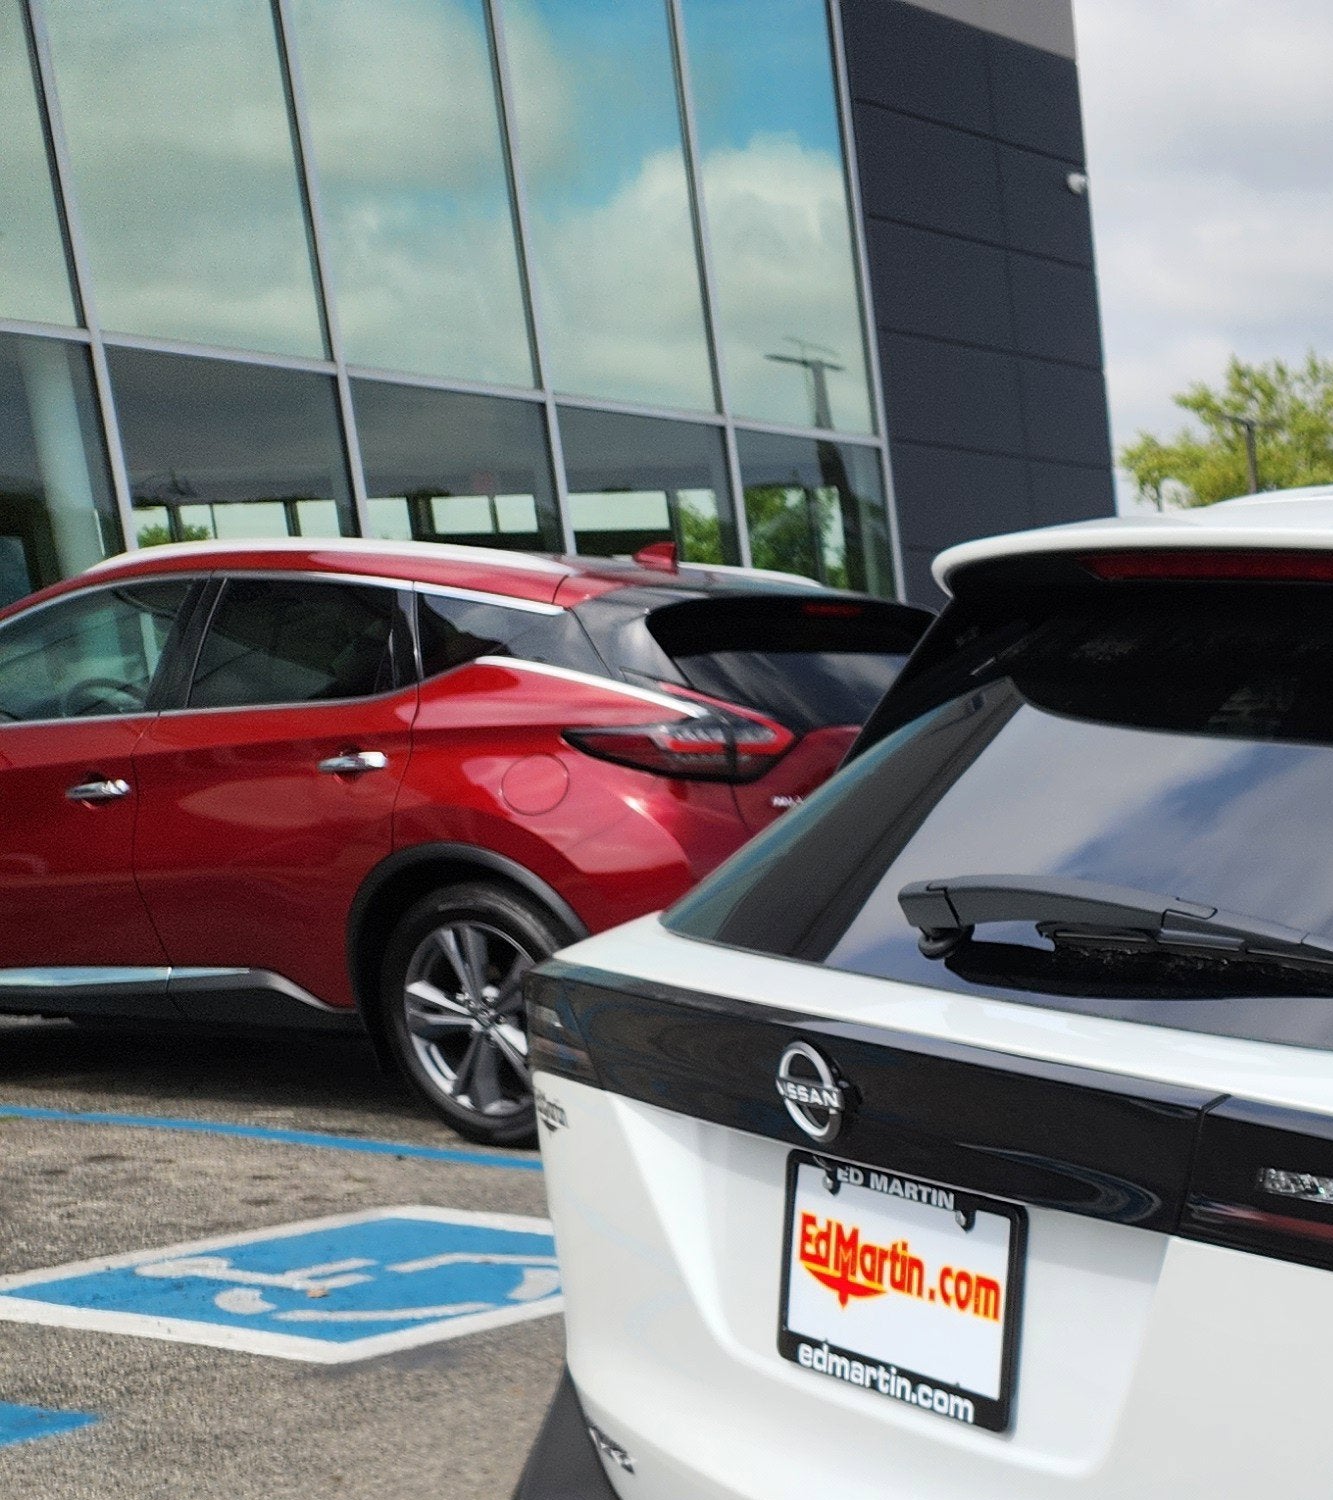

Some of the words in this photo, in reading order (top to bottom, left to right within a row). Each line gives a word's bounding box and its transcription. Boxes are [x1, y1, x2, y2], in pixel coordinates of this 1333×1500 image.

[836, 1166, 865, 1187] ED
[868, 1172, 955, 1211] MARTIN
[800, 1211, 1001, 1322] EdMartin.com
[797, 1341, 975, 1424] edmartin.com
